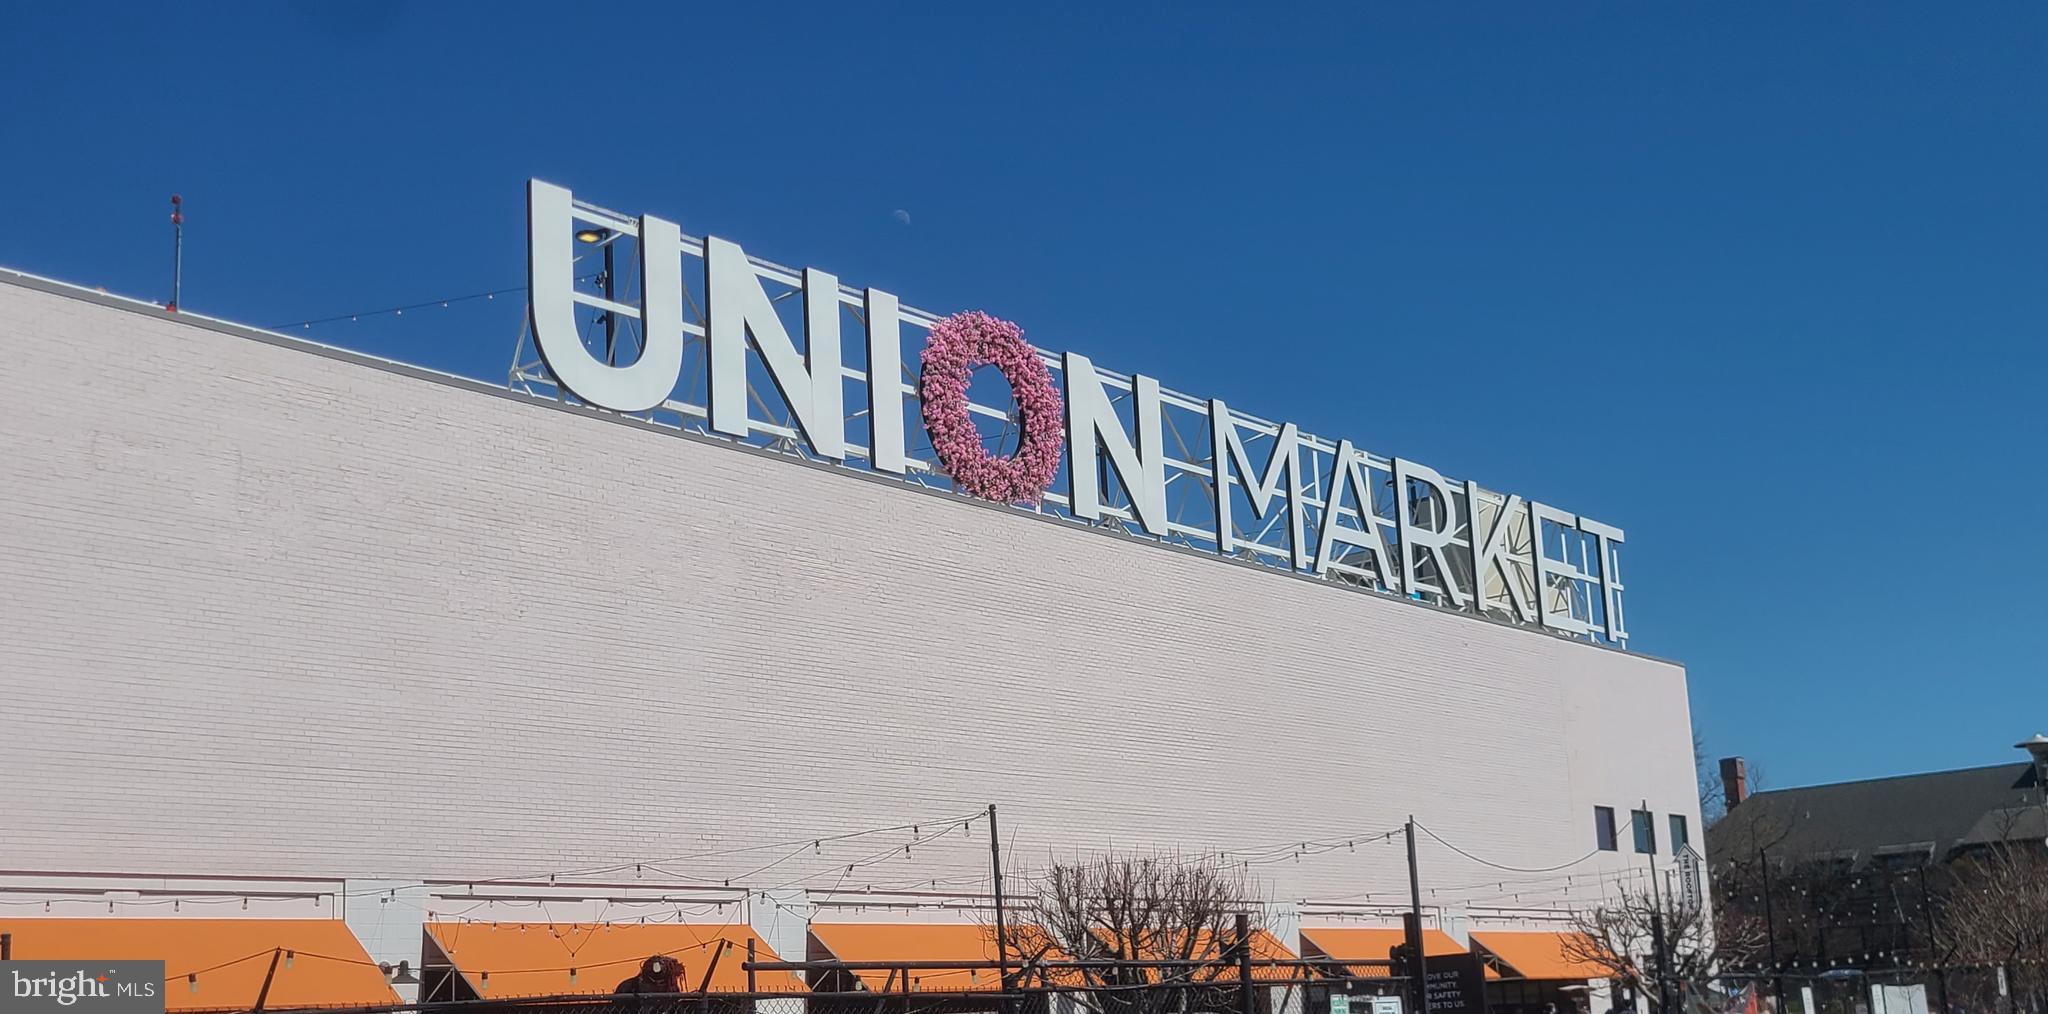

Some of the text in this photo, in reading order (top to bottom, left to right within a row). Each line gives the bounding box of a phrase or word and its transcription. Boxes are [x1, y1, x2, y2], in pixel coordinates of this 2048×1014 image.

[527, 178, 1624, 642] UNION MARKET
[1682, 854, 1690, 869] THE
